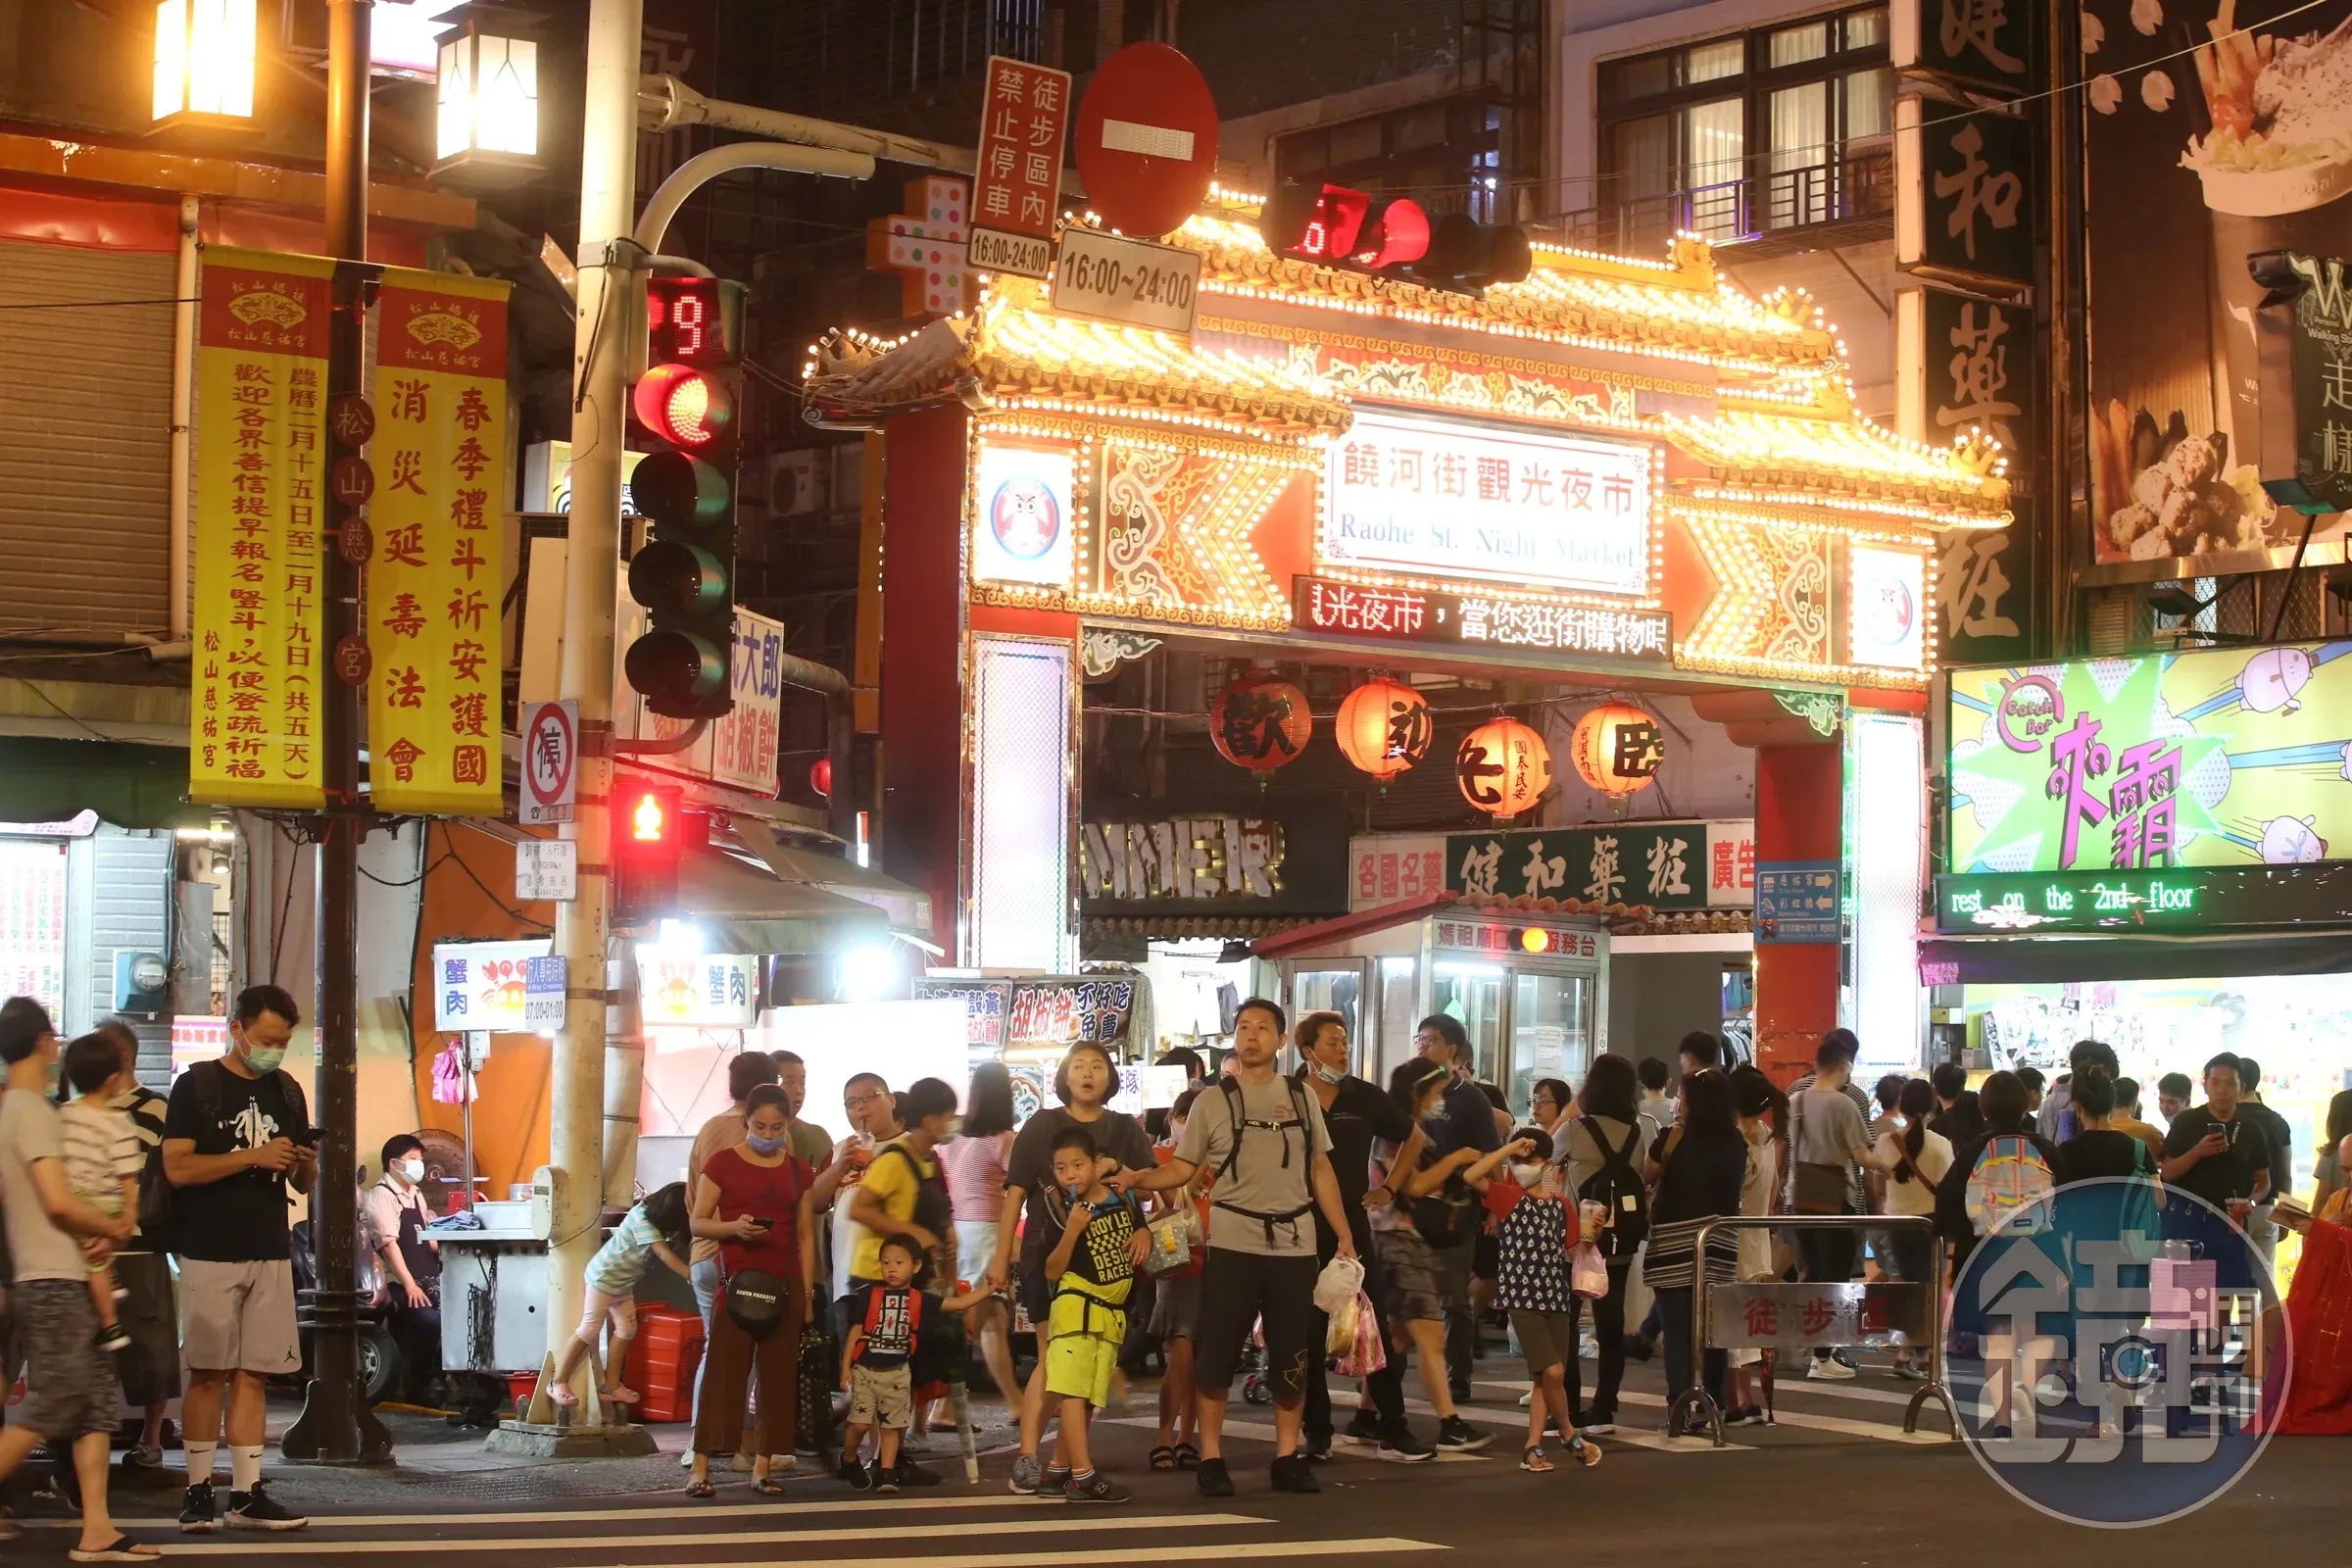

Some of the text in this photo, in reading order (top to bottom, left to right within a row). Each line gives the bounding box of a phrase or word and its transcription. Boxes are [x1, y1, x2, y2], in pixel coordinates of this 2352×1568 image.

[984, 67, 1024, 219] 禁止停車
[1020, 74, 1059, 226] 徒步區內
[974, 234, 1047, 273] 16:00-24:00
[1064, 251, 1193, 310] 16:00~24:00
[227, 327, 306, 347] 松山慈祐宮
[405, 347, 482, 368] 松山慈祐宮
[2308, 327, 2339, 344] Walking
[1344, 440, 1635, 517] 饒河街觀光夜市
[1339, 513, 1635, 568] Raohe St. Night Market
[382, 378, 429, 784] 消災延壽法會
[447, 385, 493, 786] 春季禮斗祈安護國
[202, 629, 220, 768] 松山慈祐宮
[1223, 691, 1298, 760] 歡
[2006, 697, 2055, 718] Catch
[537, 726, 562, 779] 停
[716, 703, 776, 780] 胡椒餅
[2026, 718, 2053, 736] Bar
[1511, 740, 1530, 801] 國泰民安
[1357, 852, 1443, 899] 各國名藥
[1460, 835, 1691, 904] 健和藥粧
[1951, 881, 2194, 912] rest on the 2nd floor
[445, 958, 467, 1015] 蟹肉
[525, 1000, 564, 1020] 07:00-01:00
[1078, 982, 1131, 1011] 不好吃
[1011, 987, 1076, 1043] 胡椒餅
[1081, 1013, 1117, 1042] 免費
